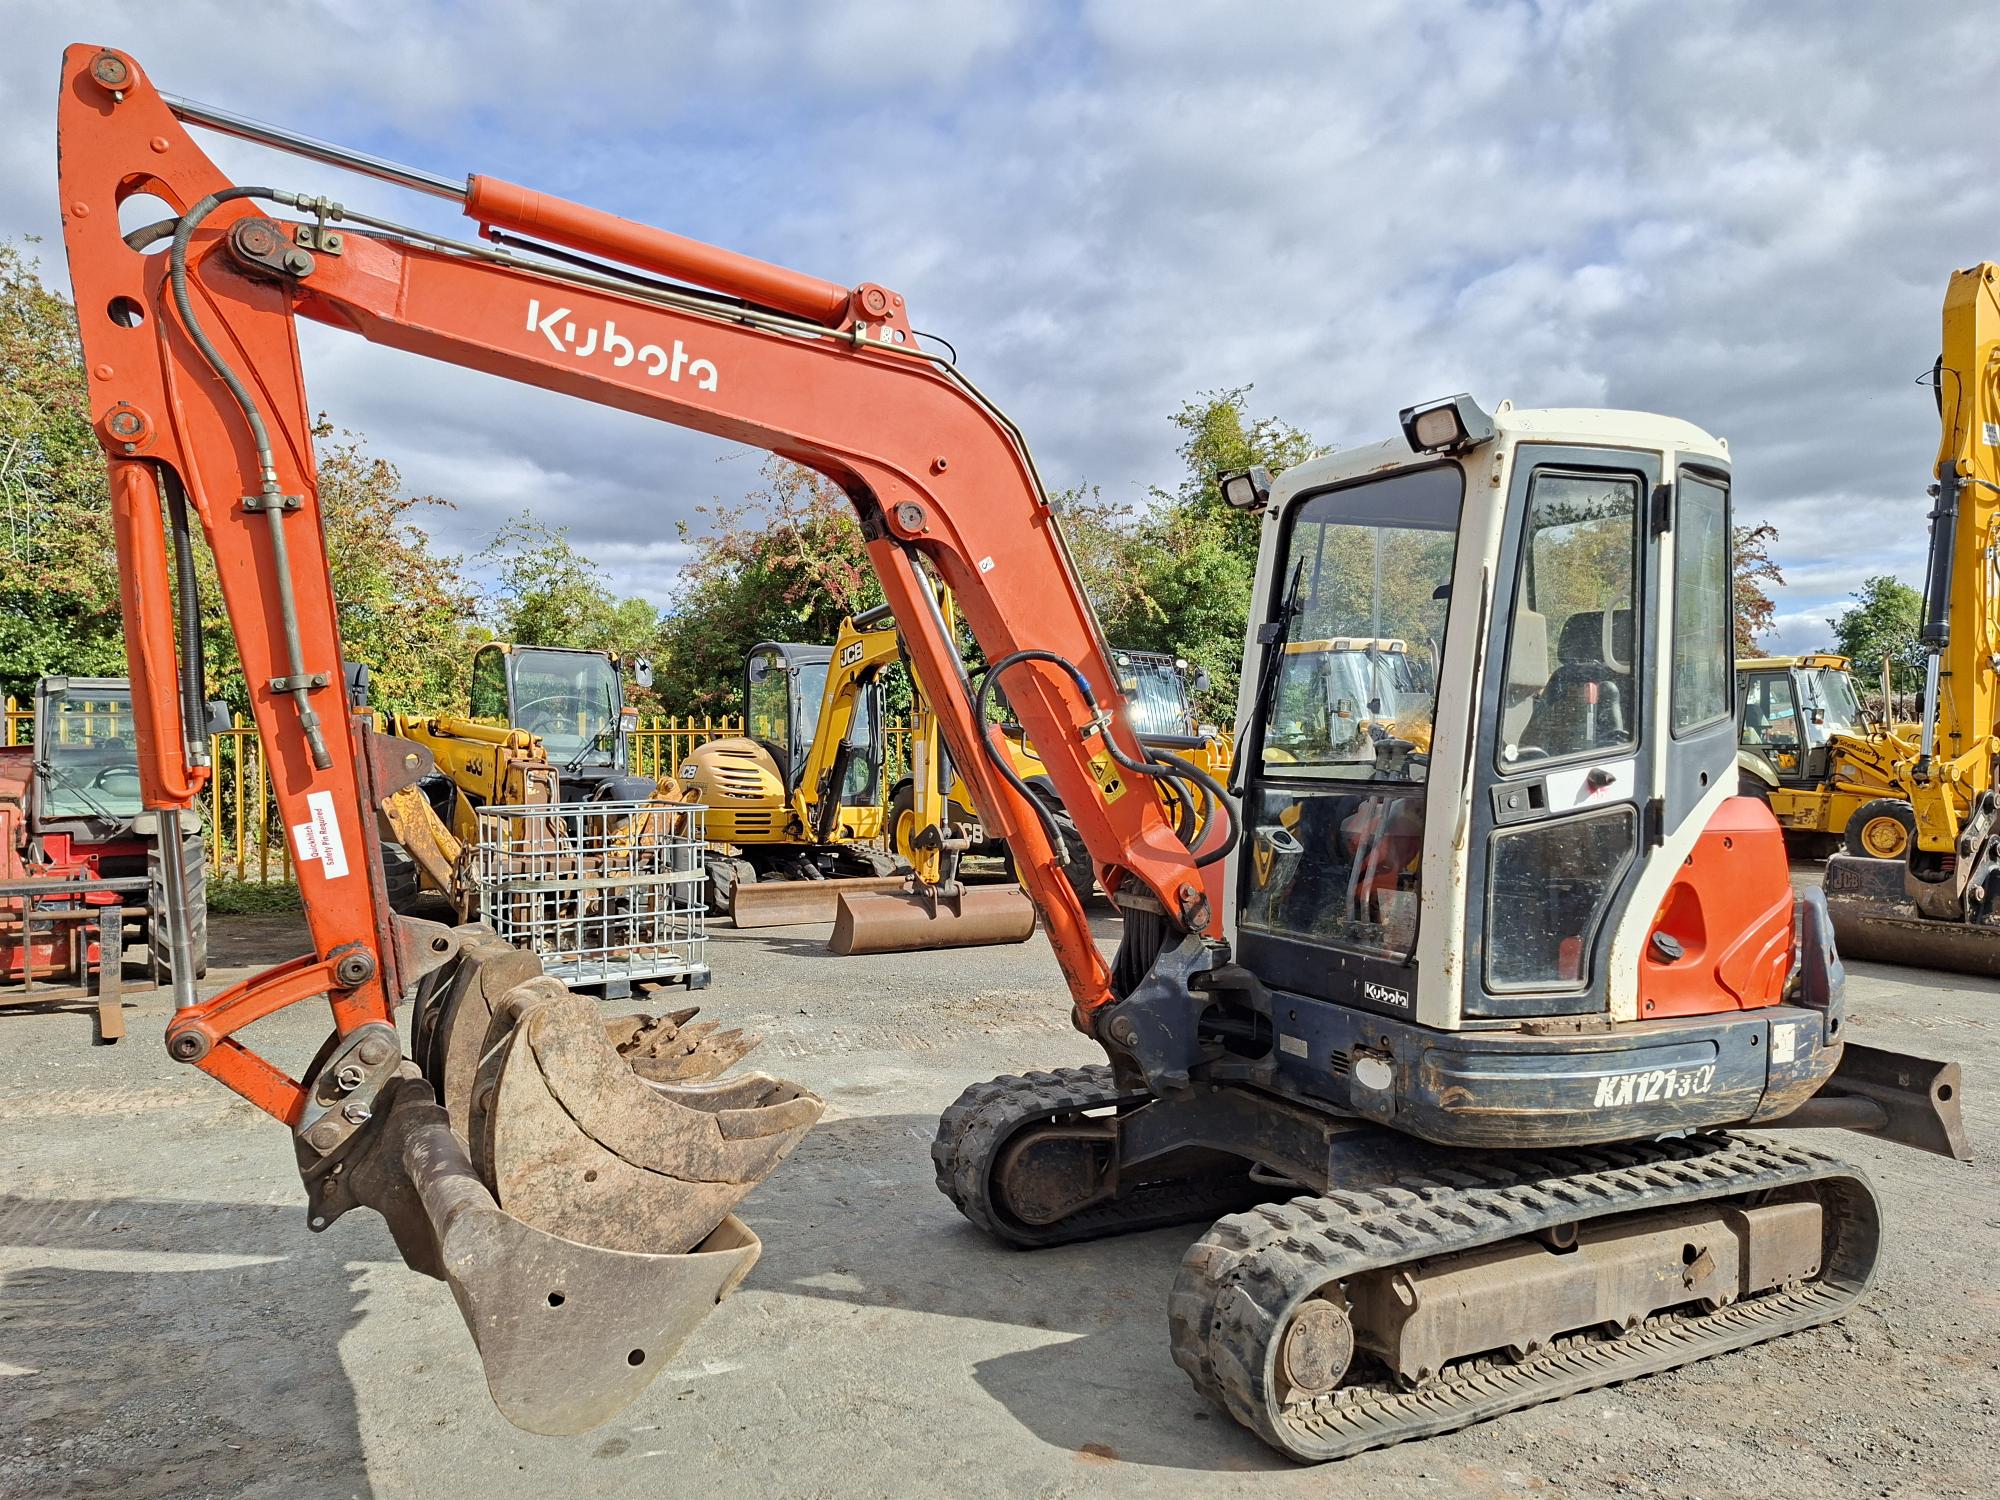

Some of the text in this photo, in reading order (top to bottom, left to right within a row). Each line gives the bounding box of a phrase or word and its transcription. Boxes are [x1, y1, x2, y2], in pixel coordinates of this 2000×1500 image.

[526, 299, 718, 392] Kubota
[840, 642, 863, 667] JCB
[304, 825, 319, 857] Quickhitch
[314, 808, 334, 865] Safety Pin Required
[962, 822, 984, 844] CB
[1833, 867, 1859, 889] JCB
[1366, 983, 1407, 1007] Kubota
